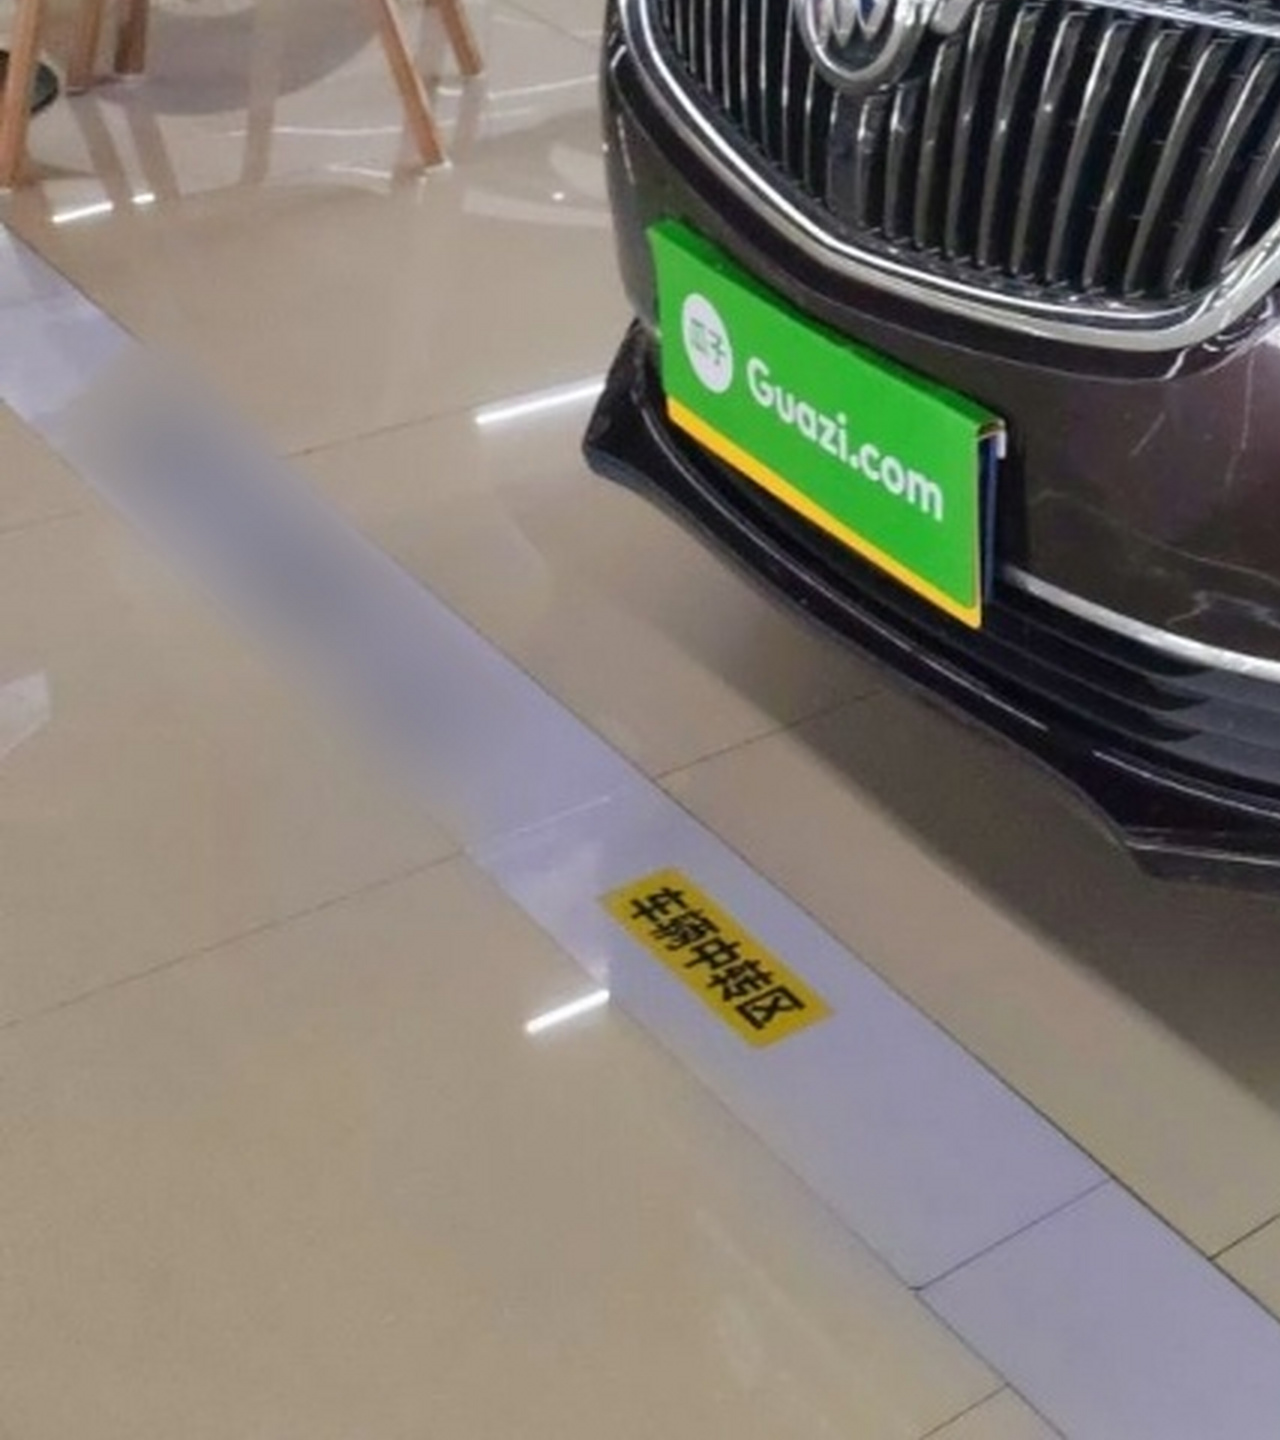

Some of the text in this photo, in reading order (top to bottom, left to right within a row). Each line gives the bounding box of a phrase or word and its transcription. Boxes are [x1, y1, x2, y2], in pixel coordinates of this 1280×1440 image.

[746, 356, 945, 522] Guazi.com
[629, 886, 806, 1031] 车辆中转区
